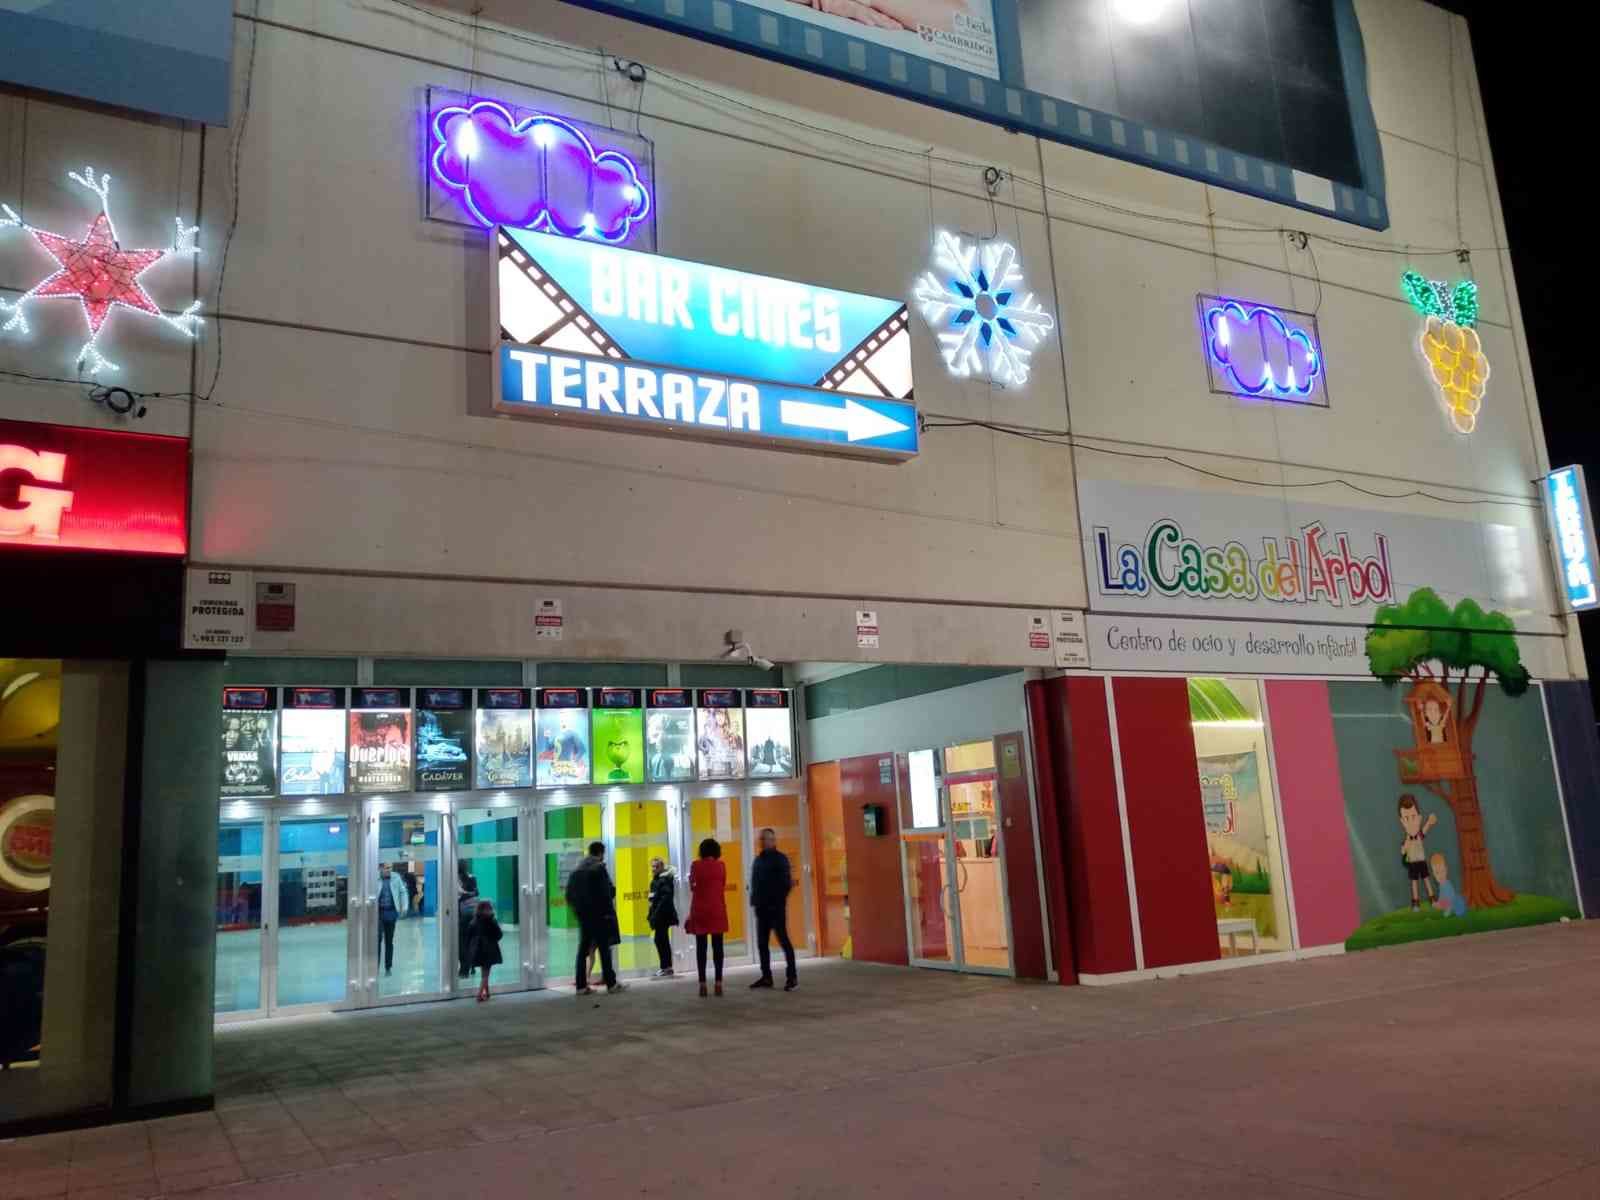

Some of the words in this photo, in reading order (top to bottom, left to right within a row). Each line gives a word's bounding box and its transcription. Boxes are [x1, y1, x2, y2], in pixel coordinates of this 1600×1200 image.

[591, 253, 695, 331] BAR
[708, 270, 842, 353] CINES
[510, 350, 761, 432] TERRAZA
[1096, 529, 1148, 595] La
[1146, 522, 1259, 596] Casa
[1260, 537, 1305, 599] del
[1304, 524, 1394, 602] Árbol
[191, 606, 245, 617] PROTEGIDA
[1106, 625, 1163, 651] Centro
[1168, 629, 1187, 652] de
[1192, 635, 1224, 654] ocio
[1228, 638, 1237, 657] y
[1245, 632, 1316, 657] desarrollo
[1317, 633, 1359, 661] infantil
